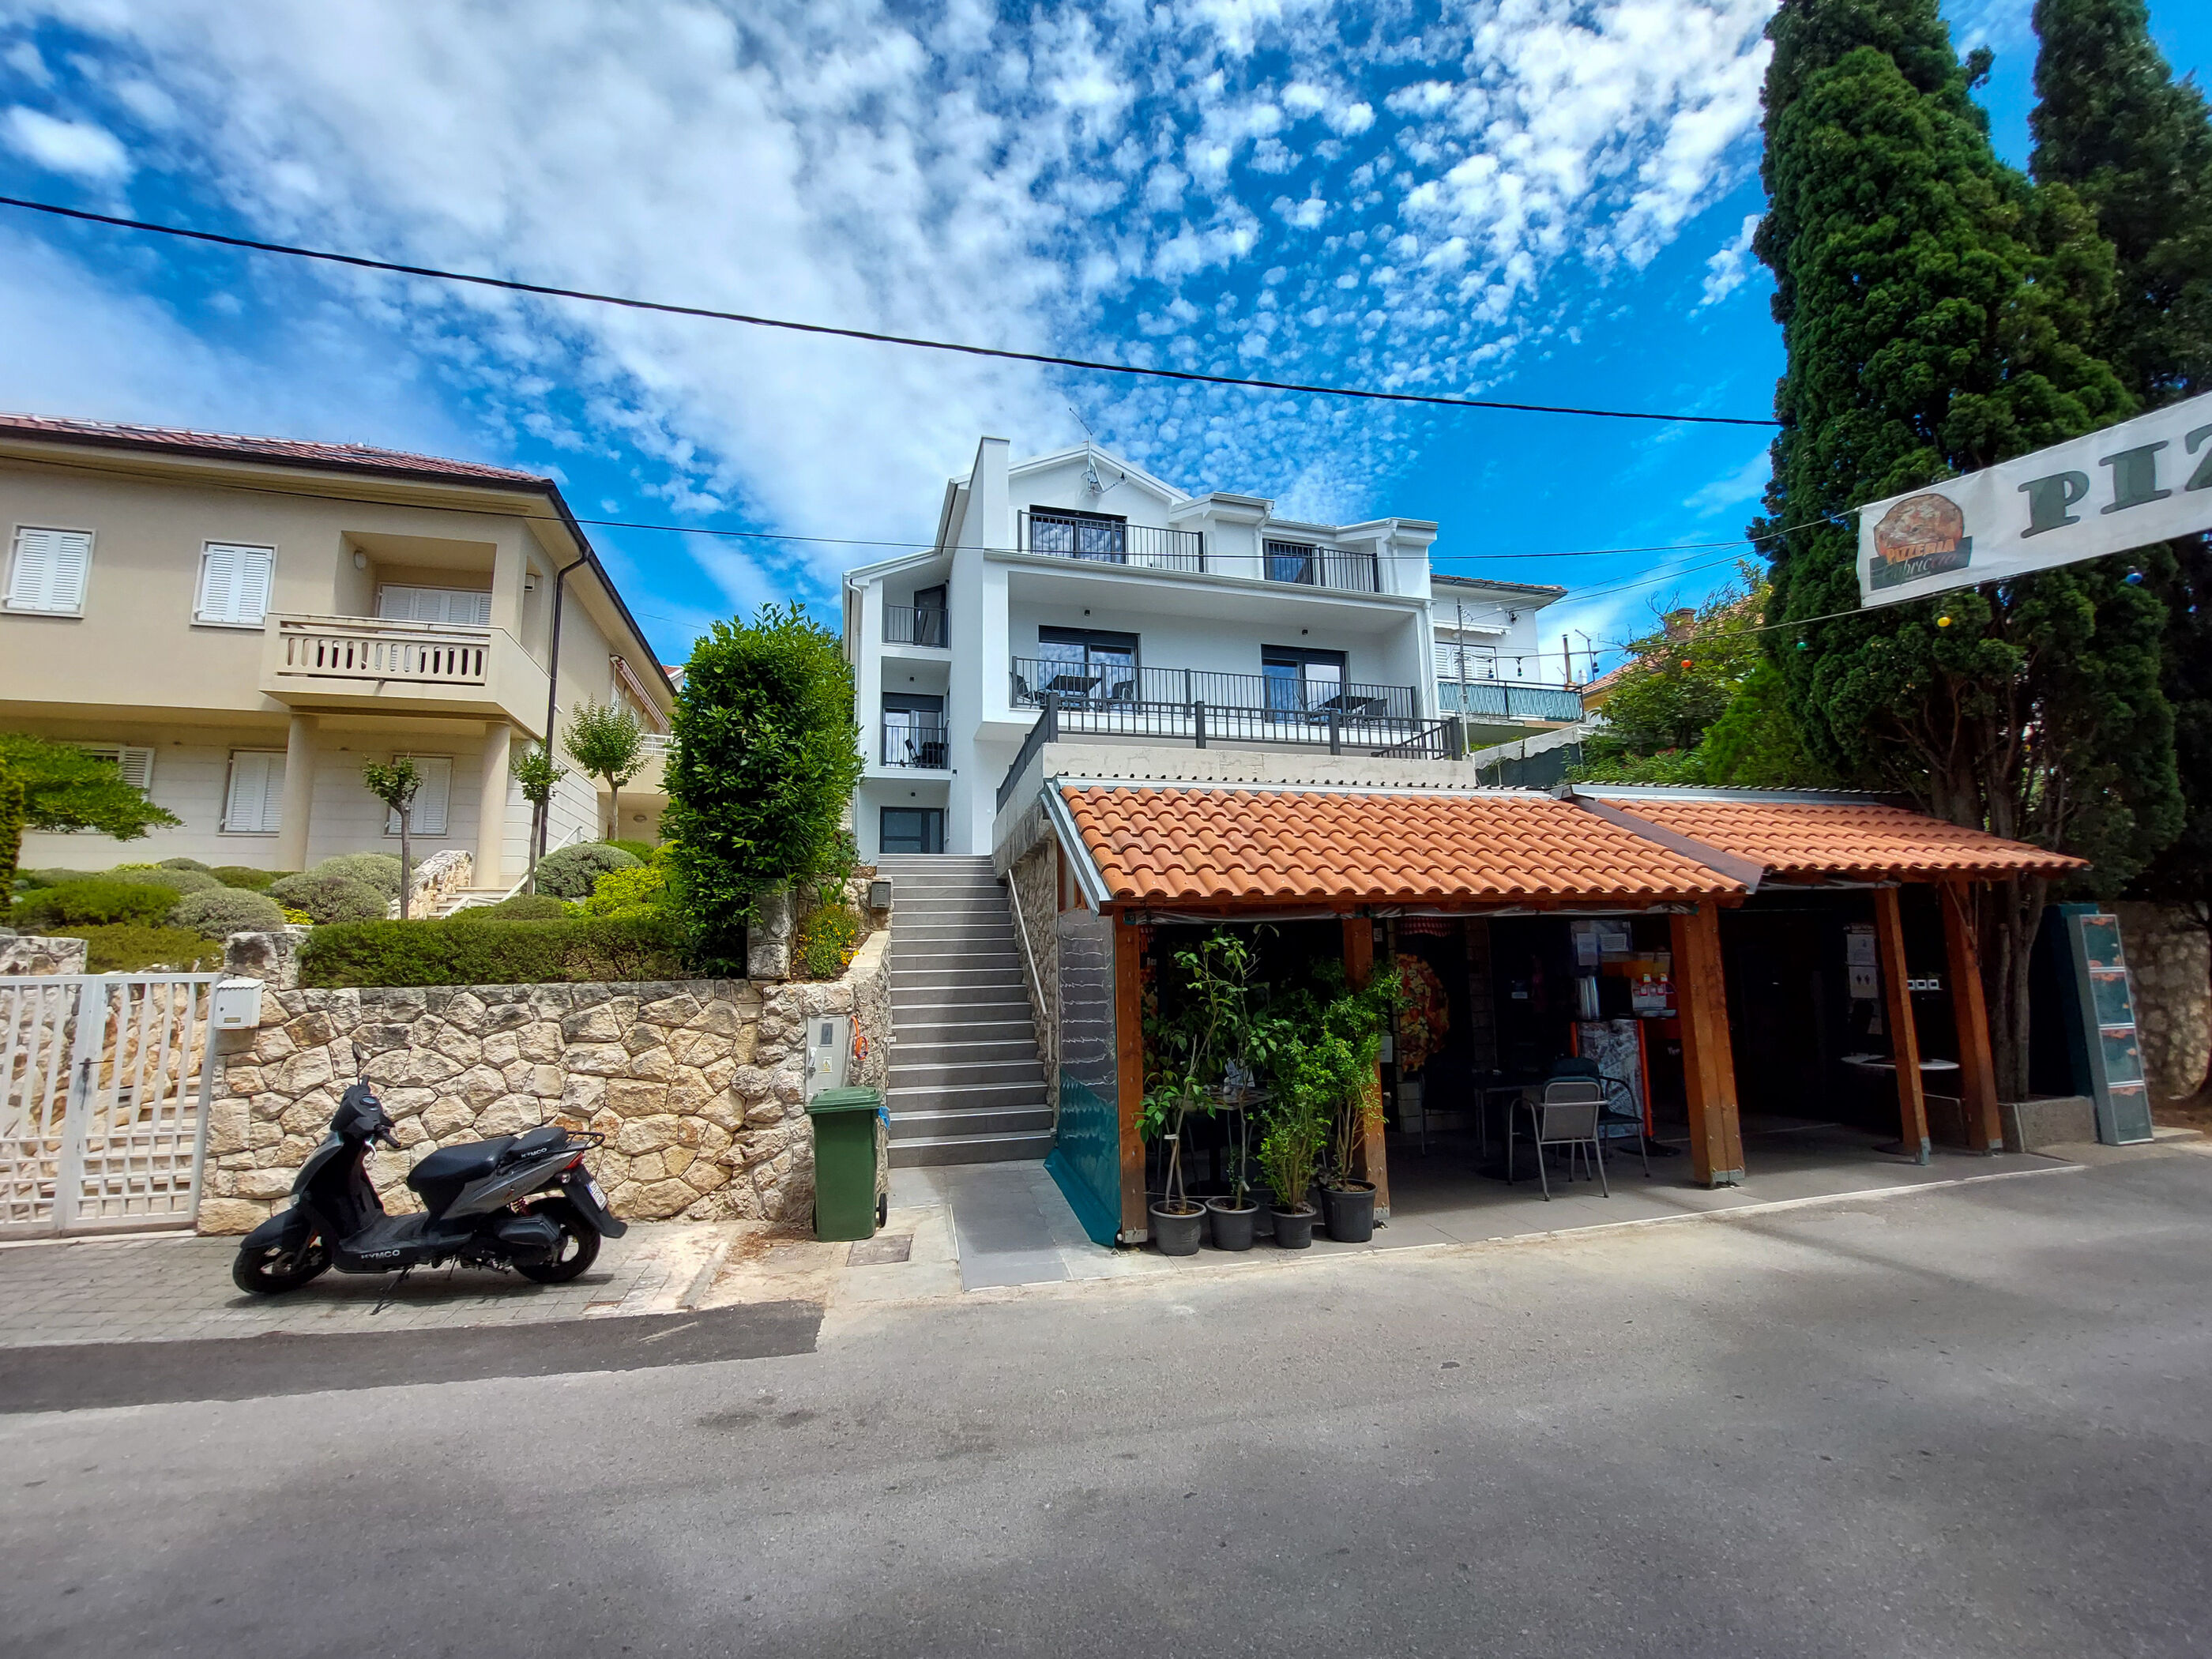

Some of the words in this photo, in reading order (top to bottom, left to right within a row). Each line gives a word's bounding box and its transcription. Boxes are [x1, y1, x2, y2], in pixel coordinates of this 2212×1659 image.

[1886, 538, 1956, 566] PIZZERIA
[521, 1147, 547, 1159] KYMCO
[360, 1249, 401, 1259] KYMCO
